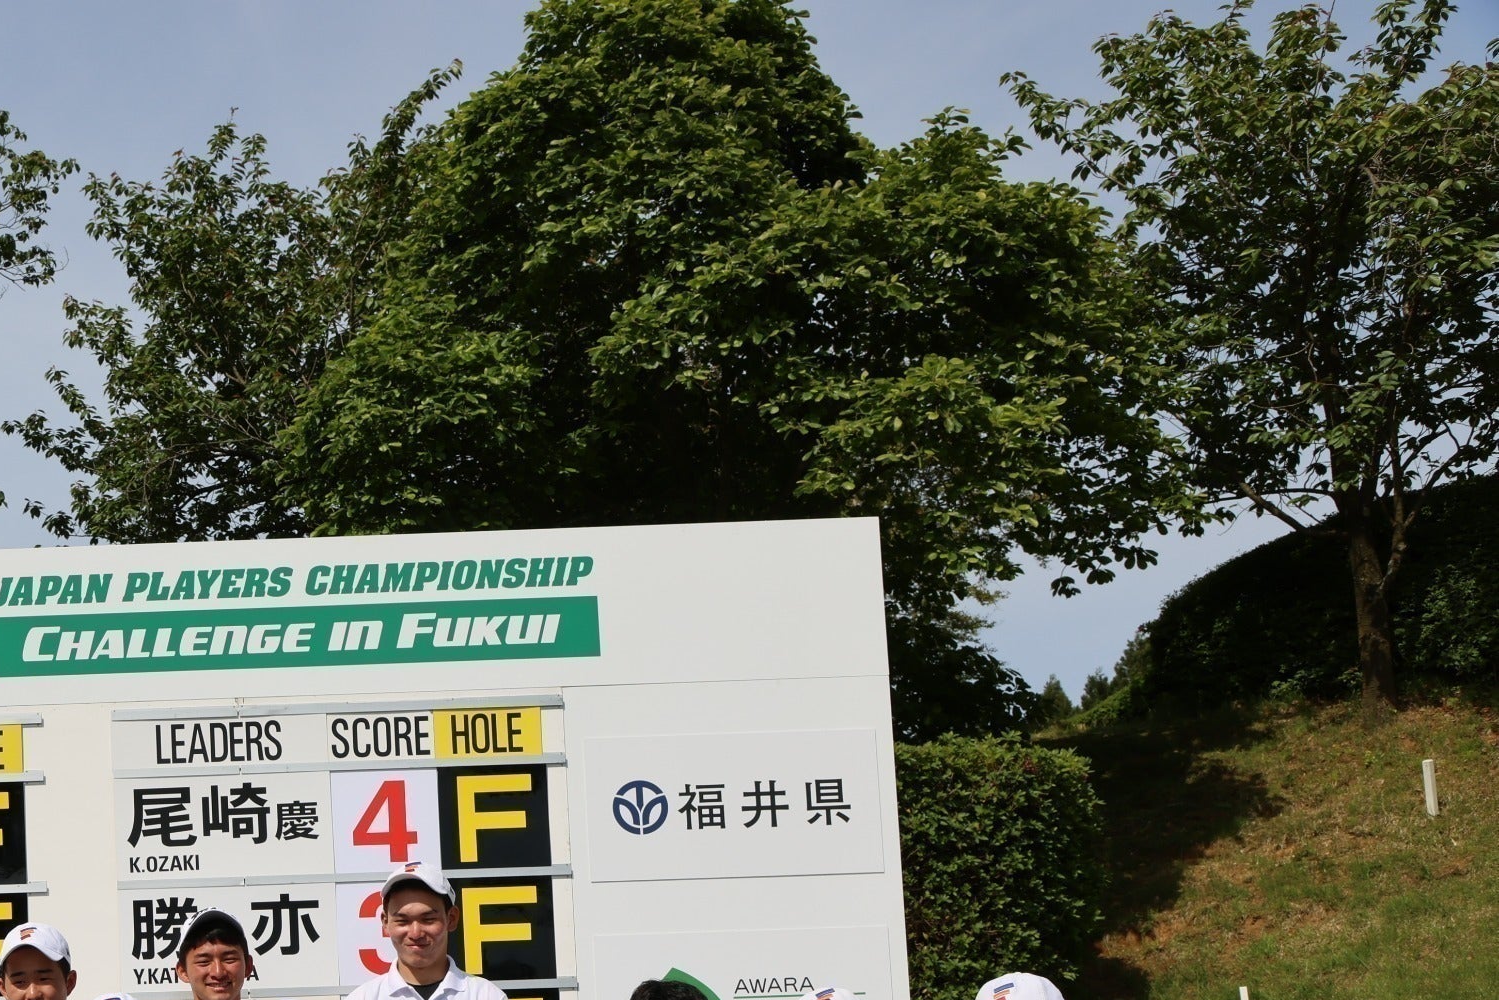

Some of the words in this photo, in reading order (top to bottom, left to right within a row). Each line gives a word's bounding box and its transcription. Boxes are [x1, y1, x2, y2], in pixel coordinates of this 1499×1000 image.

[122, 566, 294, 602] PLAYERS
[305, 556, 594, 596] CHAMPIONSHIP
[396, 612, 561, 649] FUKUI
[155, 720, 283, 765] LEADERS
[331, 715, 431, 759] SCORE
[450, 712, 524, 755] HOLE
[352, 779, 419, 863] 4
[457, 773, 533, 863] F
[677, 777, 852, 831] 福井県
[129, 854, 200, 874] K.OZAKI
[461, 886, 538, 975] F
[734, 976, 815, 995] AWARA
